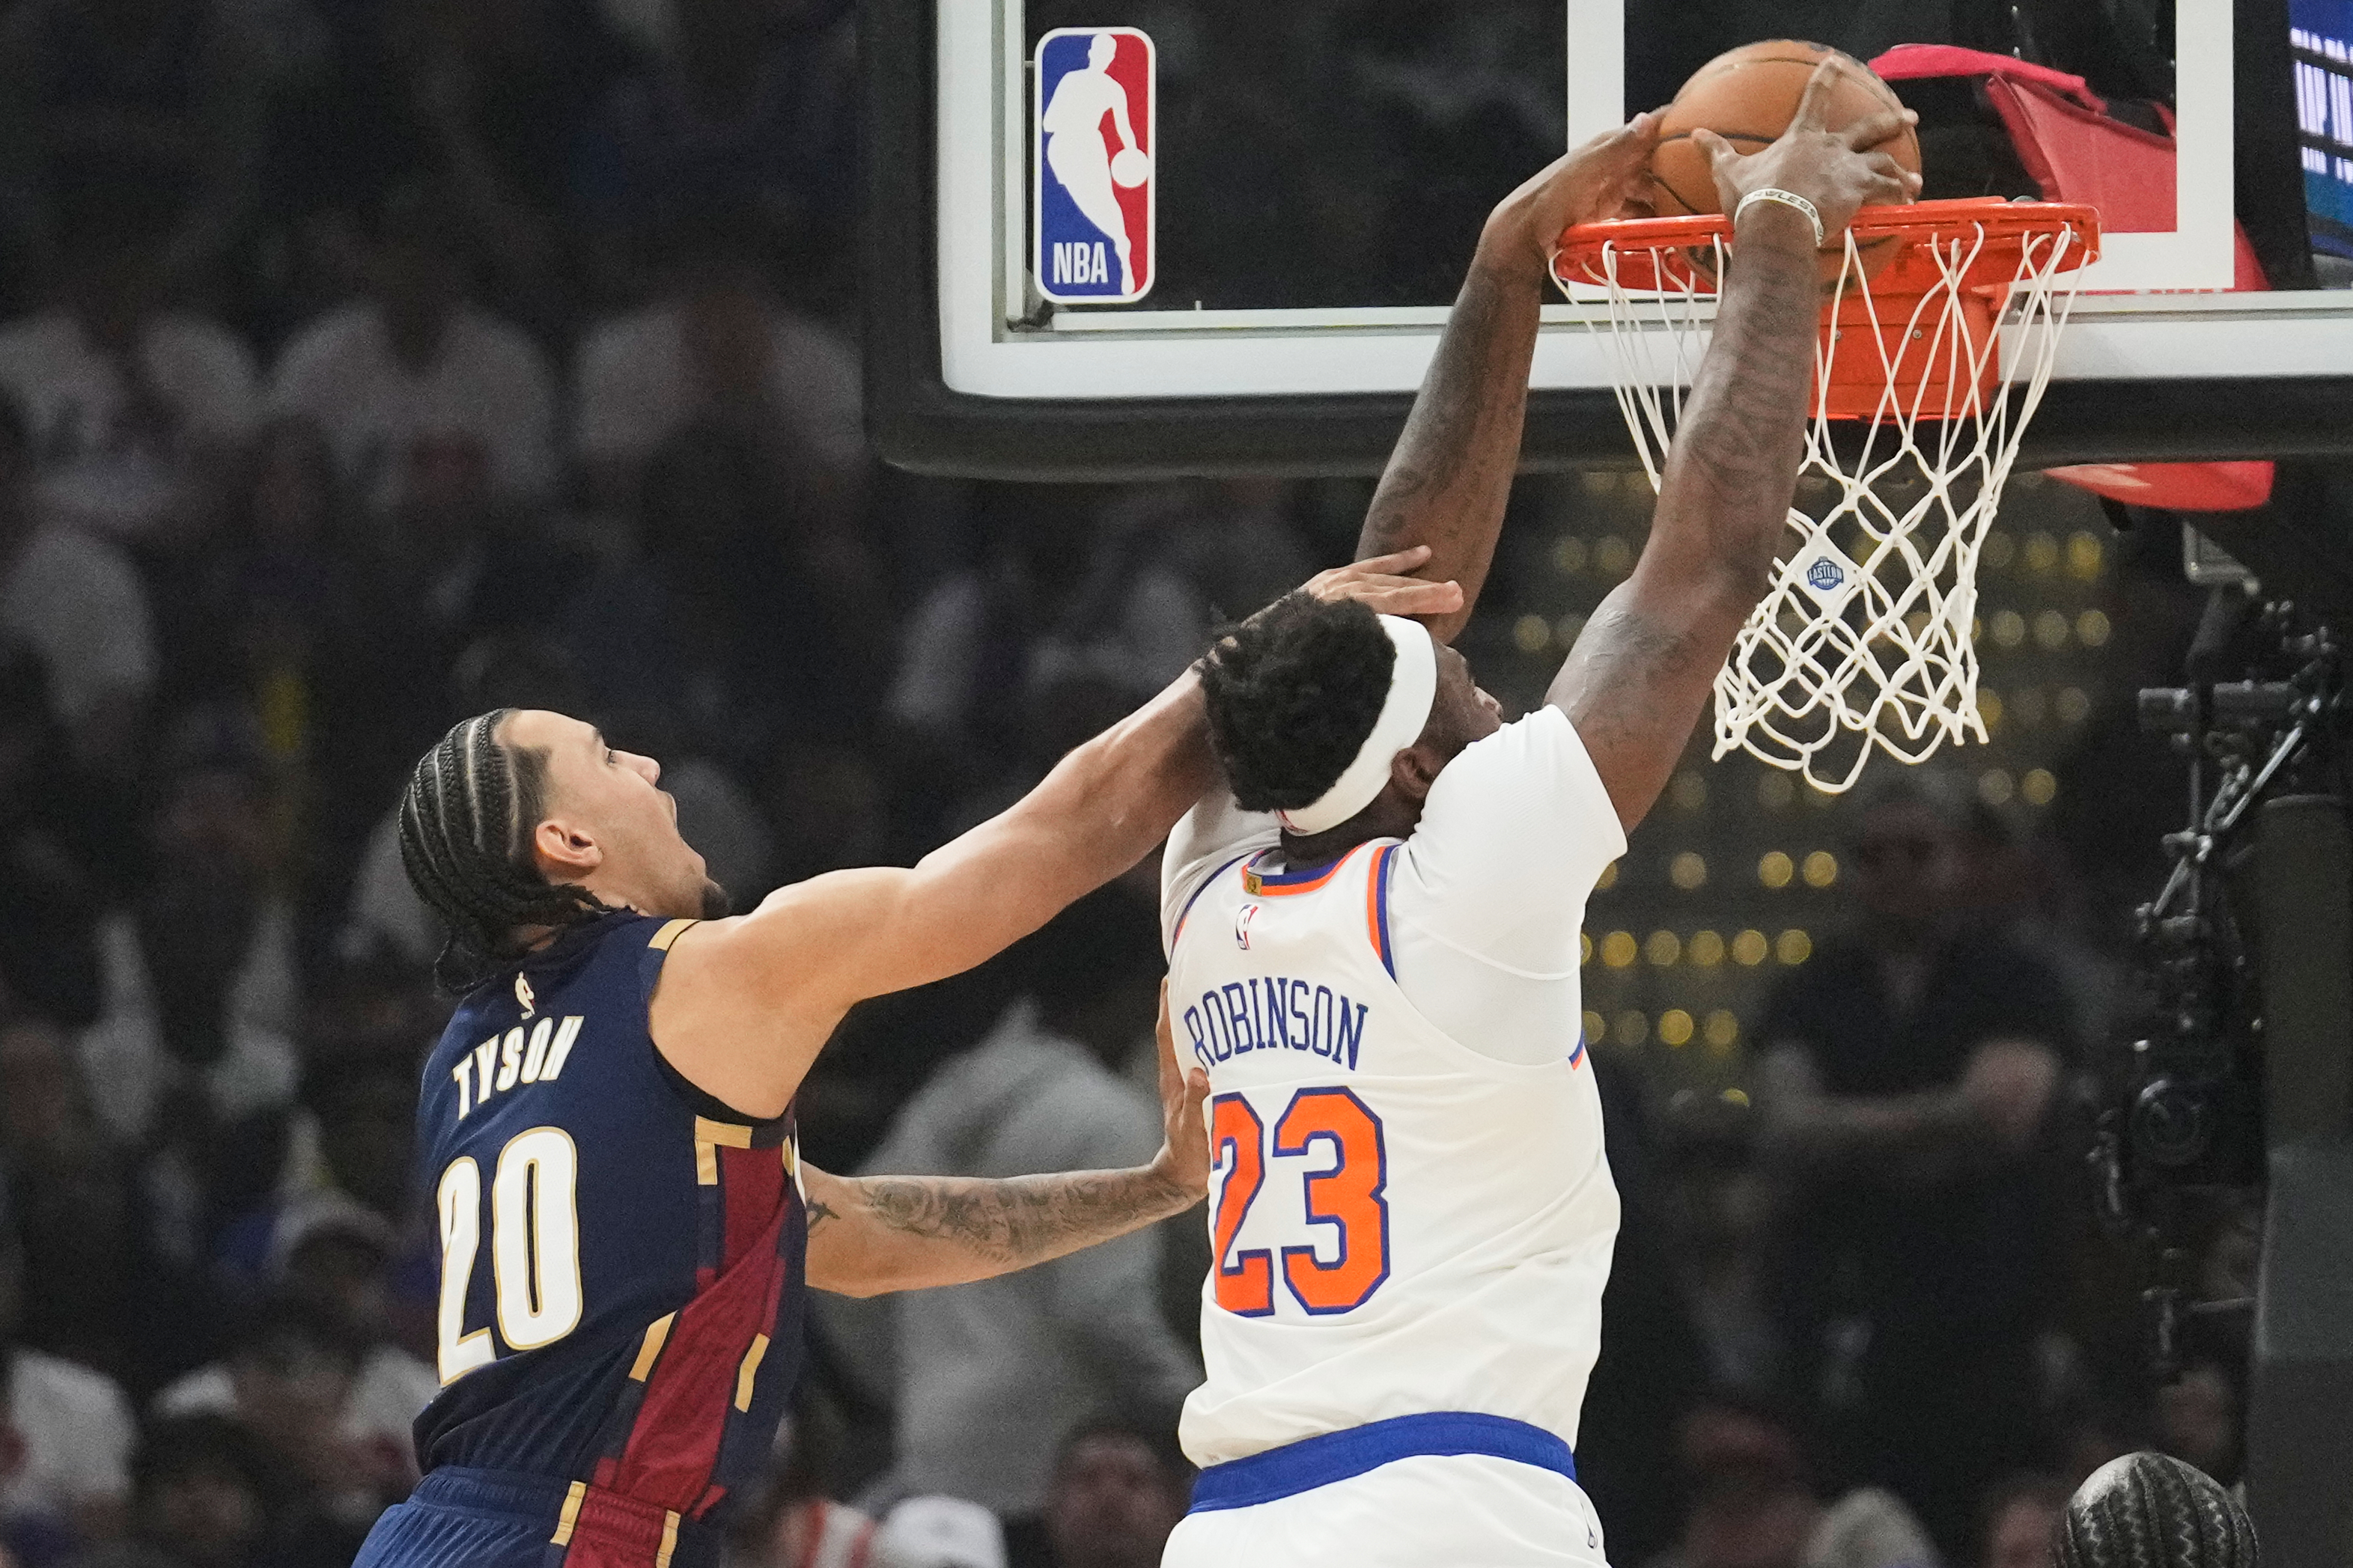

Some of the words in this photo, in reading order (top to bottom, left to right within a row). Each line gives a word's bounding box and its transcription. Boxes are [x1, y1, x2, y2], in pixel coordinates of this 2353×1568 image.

[1053, 241, 1108, 284] NBA
[453, 1016, 585, 1120] TYSON
[1184, 976, 1369, 1076] ROBINSON
[1212, 1085, 1391, 1317] 23
[437, 1126, 583, 1388] 20
